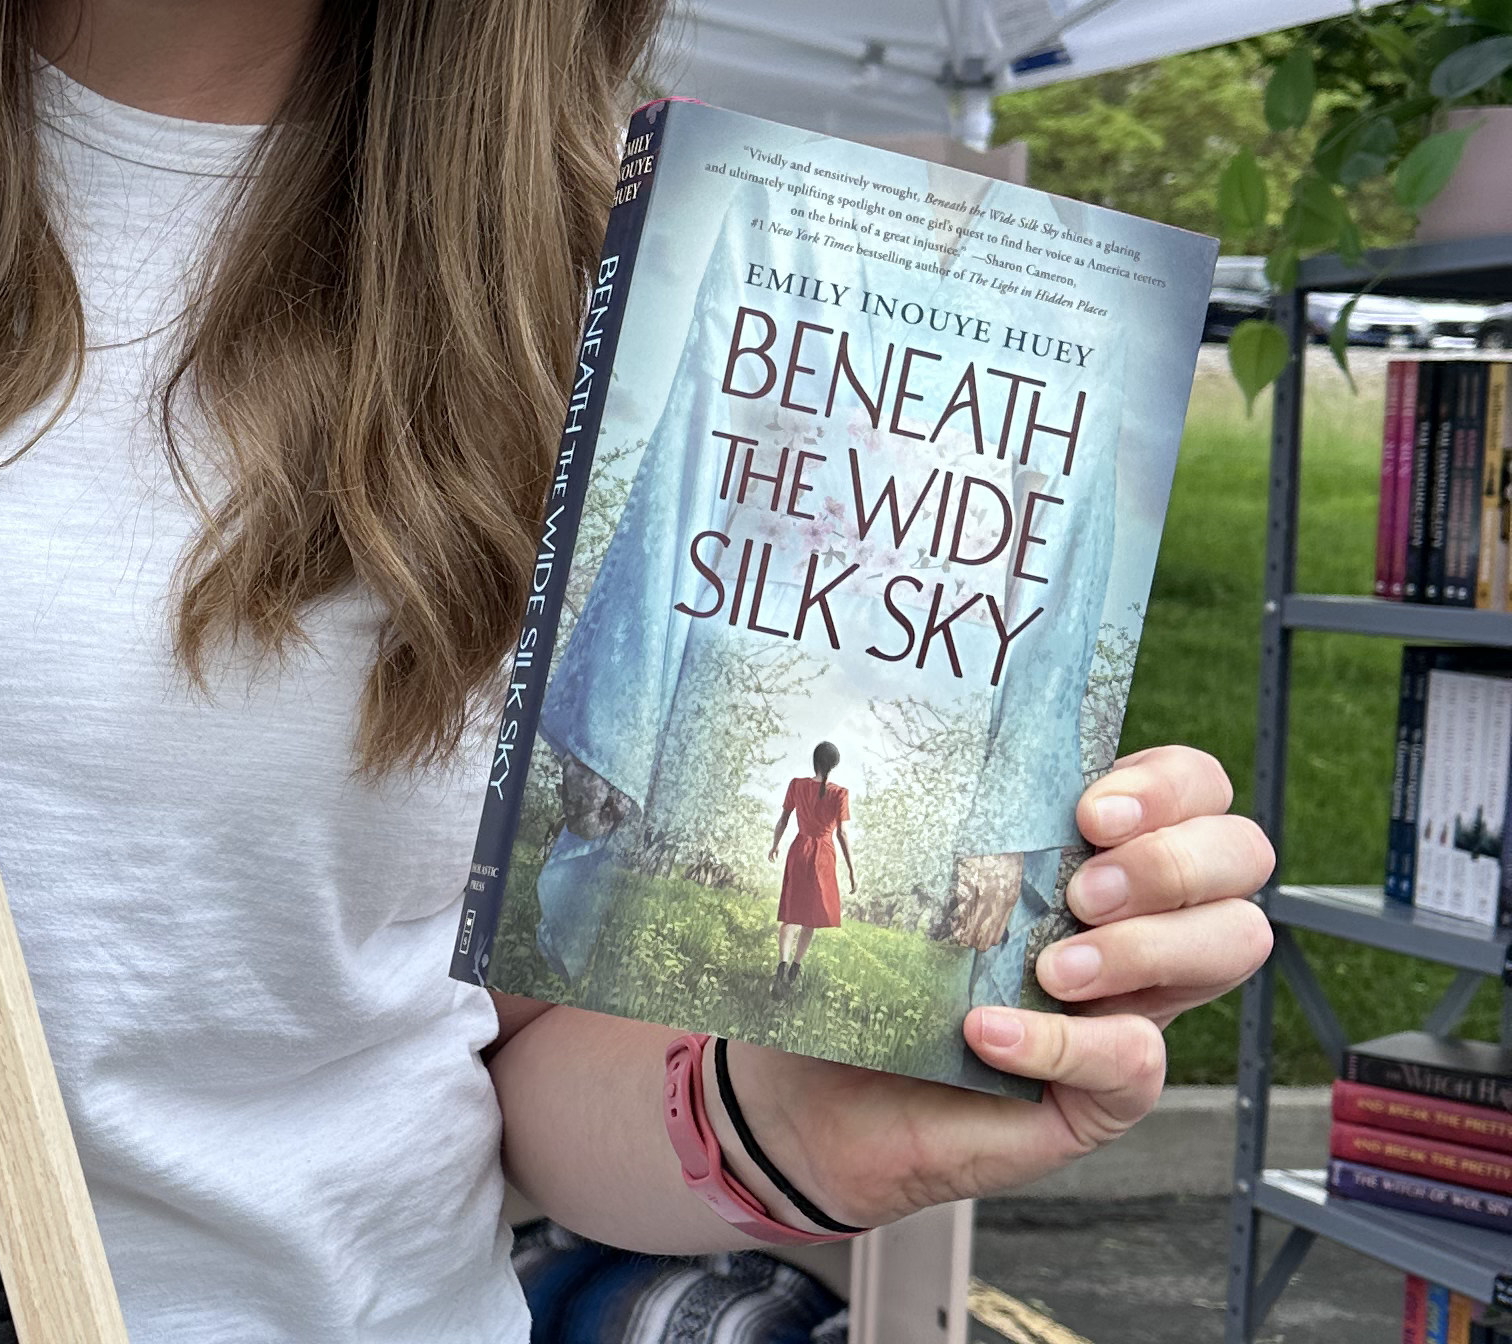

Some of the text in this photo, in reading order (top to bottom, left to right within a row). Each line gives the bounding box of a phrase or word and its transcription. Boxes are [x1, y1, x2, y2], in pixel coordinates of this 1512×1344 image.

[618, 156, 655, 182] OUYE
[624, 132, 654, 159] MILY
[704, 162, 727, 175] and
[729, 166, 787, 189] ultimately
[787, 182, 835, 205] uplifting
[838, 192, 885, 216] spotlight
[888, 208, 903, 220] on
[906, 213, 926, 225] one
[956, 227, 984, 242] quest
[987, 234, 998, 245] to
[1000, 235, 1023, 251] find
[1025, 240, 1043, 256] her
[1045, 248, 1072, 264] voice
[1074, 256, 1085, 267] as
[1087, 257, 1130, 280] America
[1133, 271, 1167, 289] teeters
[743, 145, 1141, 261] “Vividly and sensitively wrought, Beneath the Wide Silk Sky shines a glaring
[790, 206, 805, 218] on
[808, 209, 826, 223] the
[828, 213, 858, 232] brink
[860, 222, 875, 235] of
[874, 228, 881, 238] a
[883, 230, 910, 247] great
[912, 234, 967, 259] injustice.”
[1026, 263, 1077, 288] Cameron,
[745, 261, 1096, 370] EMILY INOUYE HUEY
[750, 217, 1109, 318] #1 New York Times bestselling author of The Light in Hidden Places
[721, 306, 1088, 476] BENEATH
[489, 255, 620, 801] BENEATH THE WIDE SILK SKY
[711, 429, 1065, 584] THE WIDE
[673, 529, 1044, 688] SILK SKY
[1461, 1158, 1512, 1181] PRETTY
